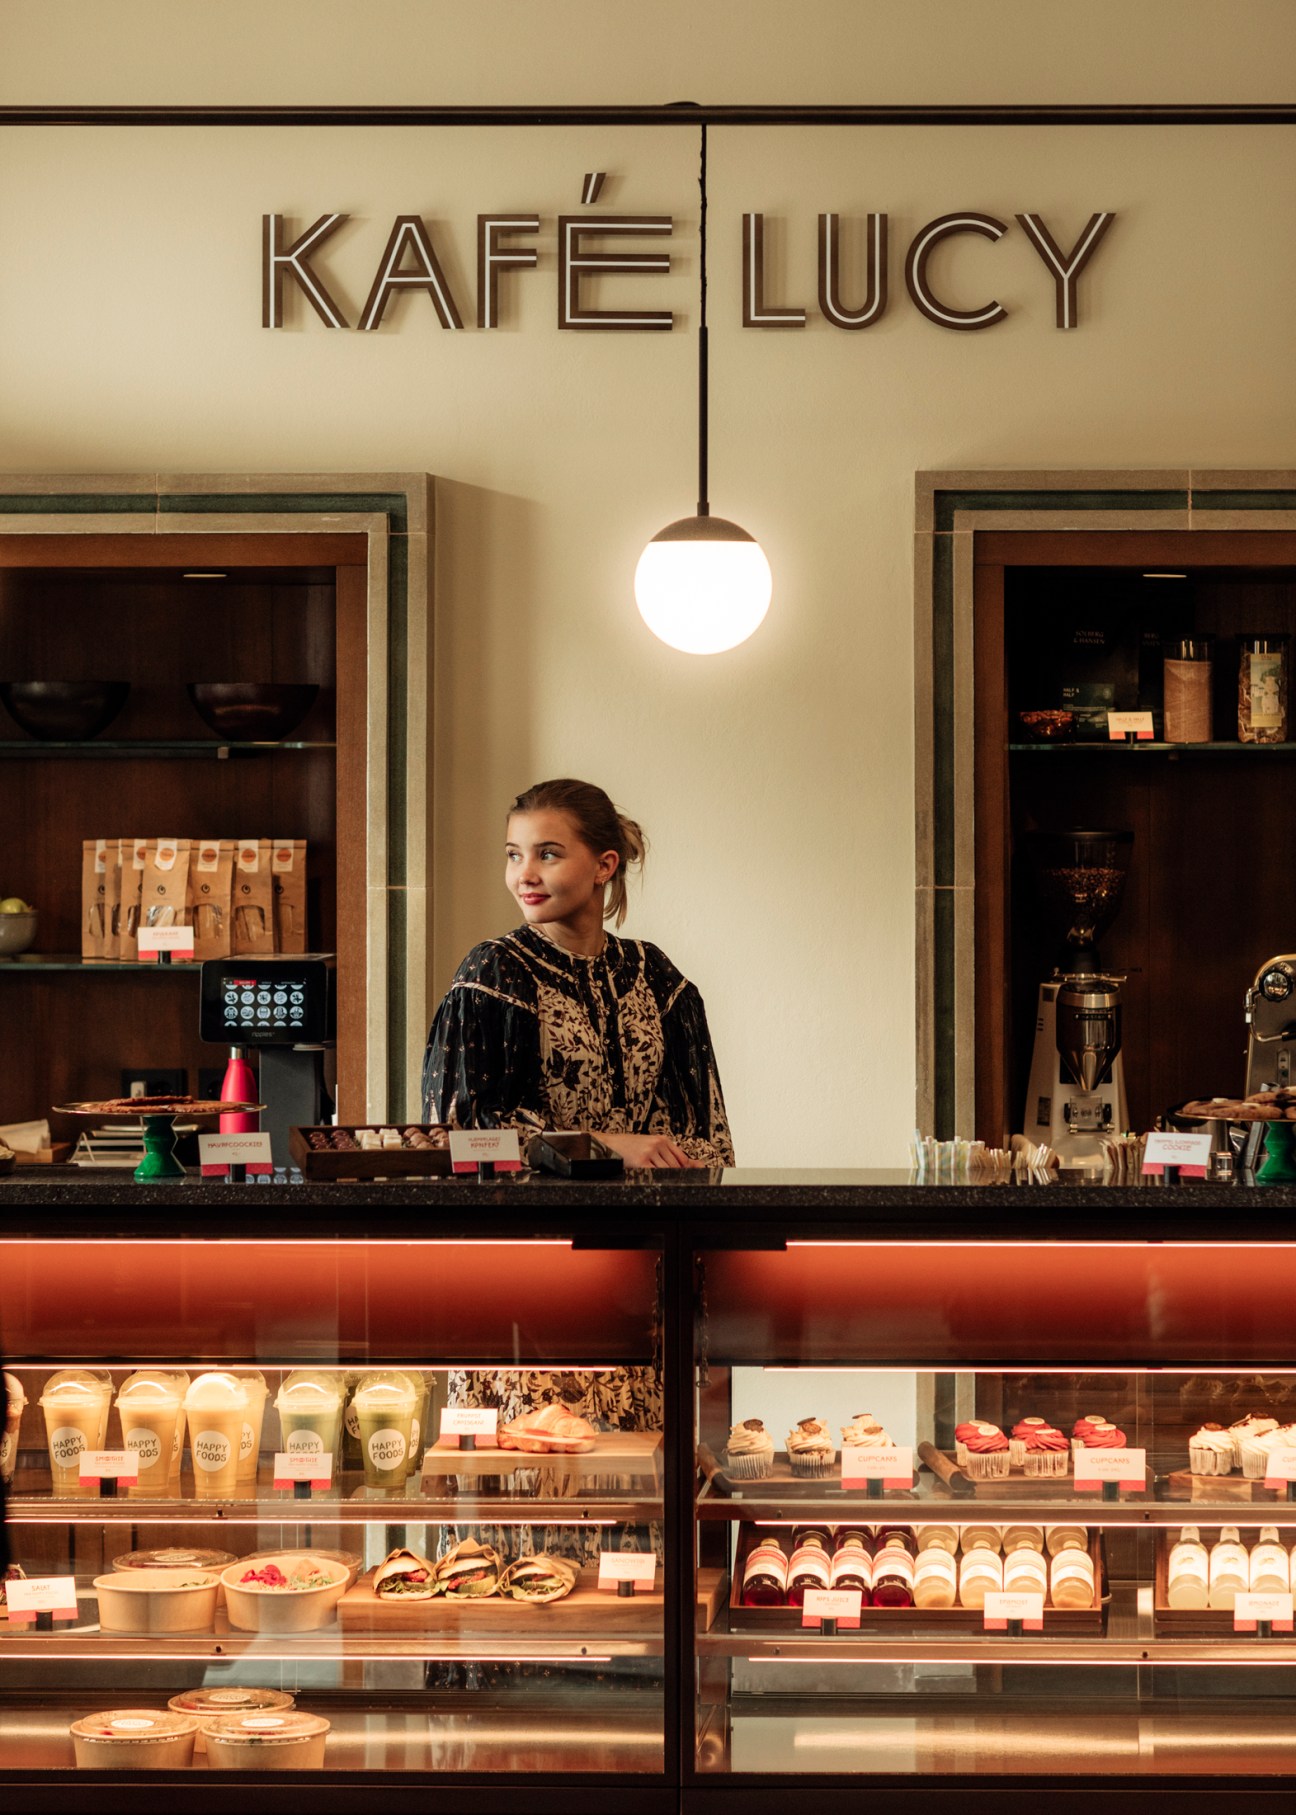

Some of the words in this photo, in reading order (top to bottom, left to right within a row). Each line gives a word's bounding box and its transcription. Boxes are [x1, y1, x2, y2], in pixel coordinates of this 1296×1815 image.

[262, 172, 673, 331] KAFÉ
[742, 211, 1117, 331] LUCY
[53, 1435, 82, 1450] HAPPY
[127, 1438, 157, 1450] HAPPY
[197, 1440, 228, 1453] HAPPY
[289, 1440, 320, 1452] HAPPY
[371, 1438, 403, 1452] HAPPY
[55, 1444, 86, 1460] FOODS
[196, 1449, 228, 1463] FOODS
[372, 1448, 405, 1461] FOODS
